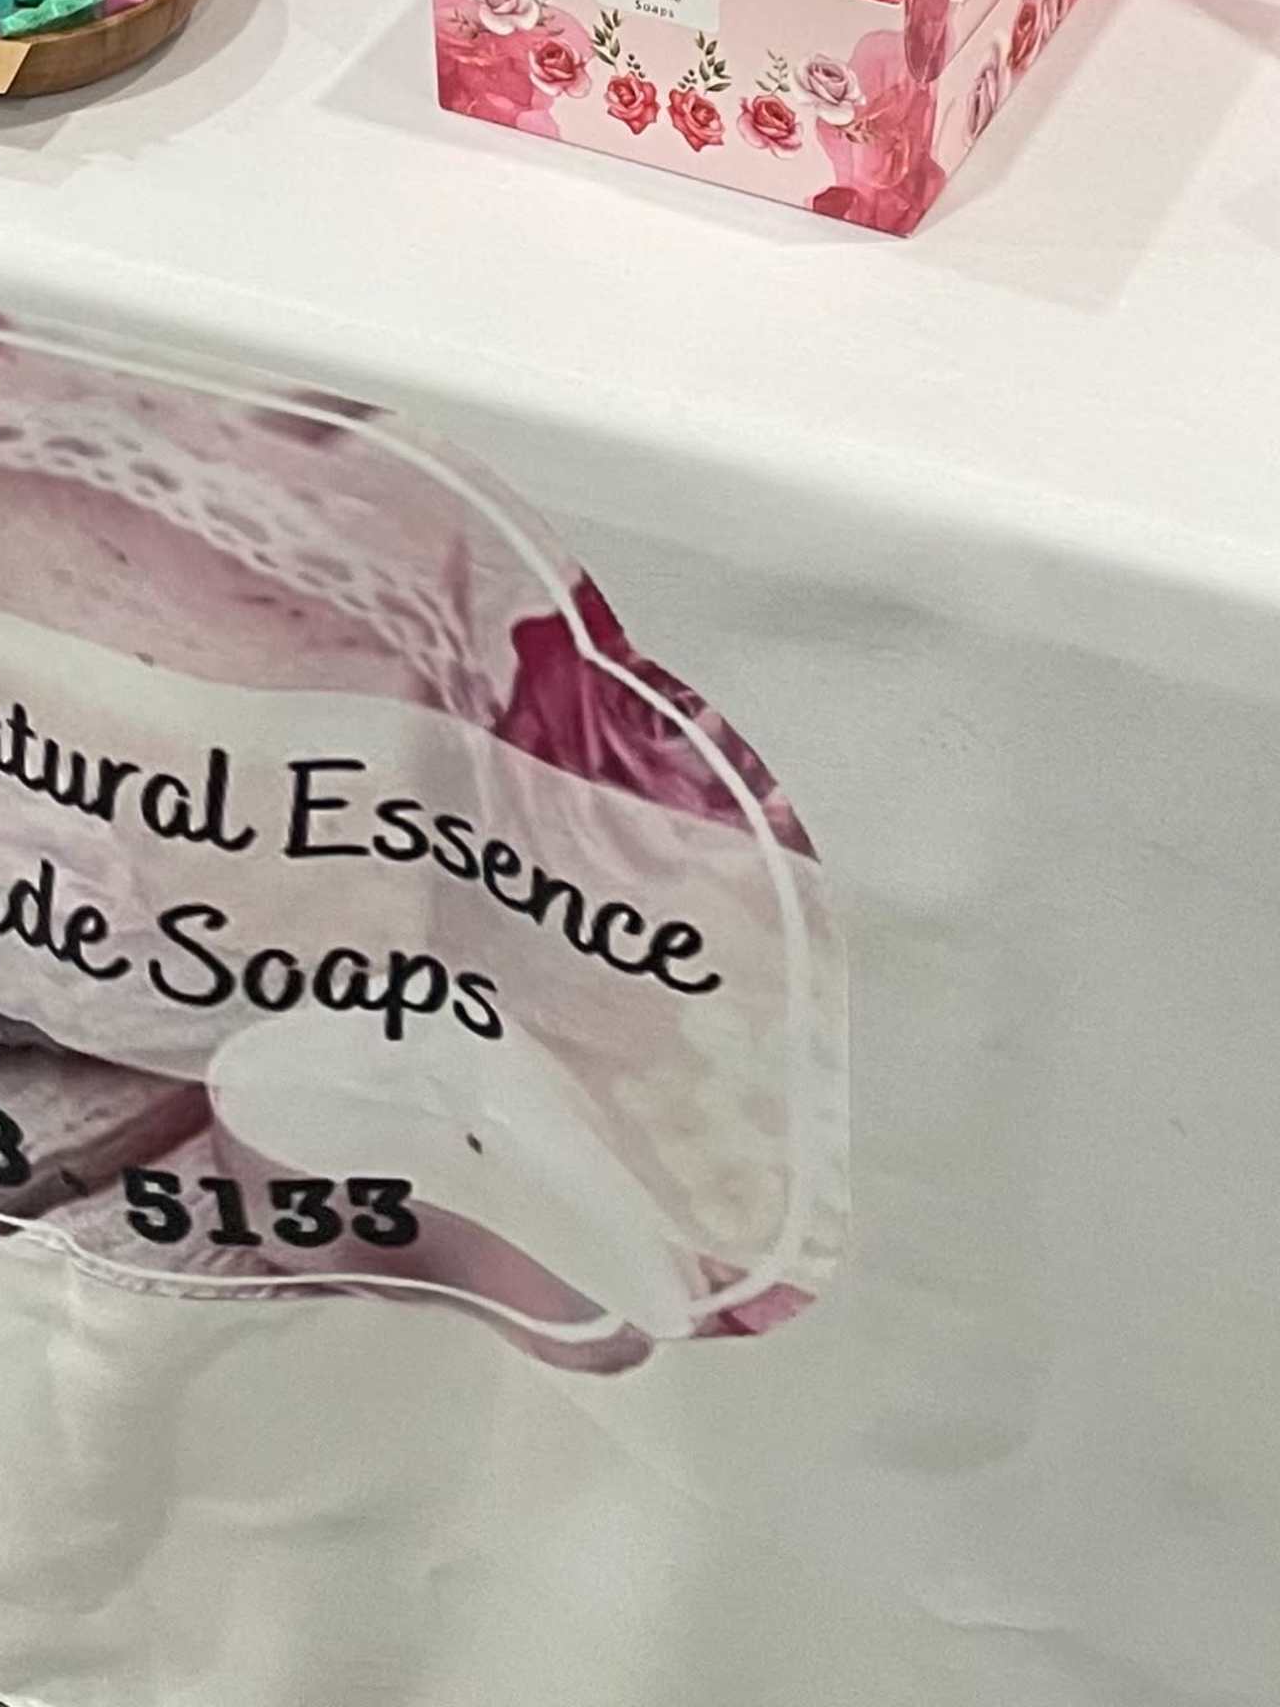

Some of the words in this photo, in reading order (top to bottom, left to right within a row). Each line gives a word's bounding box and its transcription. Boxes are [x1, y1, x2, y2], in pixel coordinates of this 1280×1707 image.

[283, 758, 722, 995] Essence
[148, 904, 503, 1041] Soaps
[120, 1168, 421, 1248] 5133
